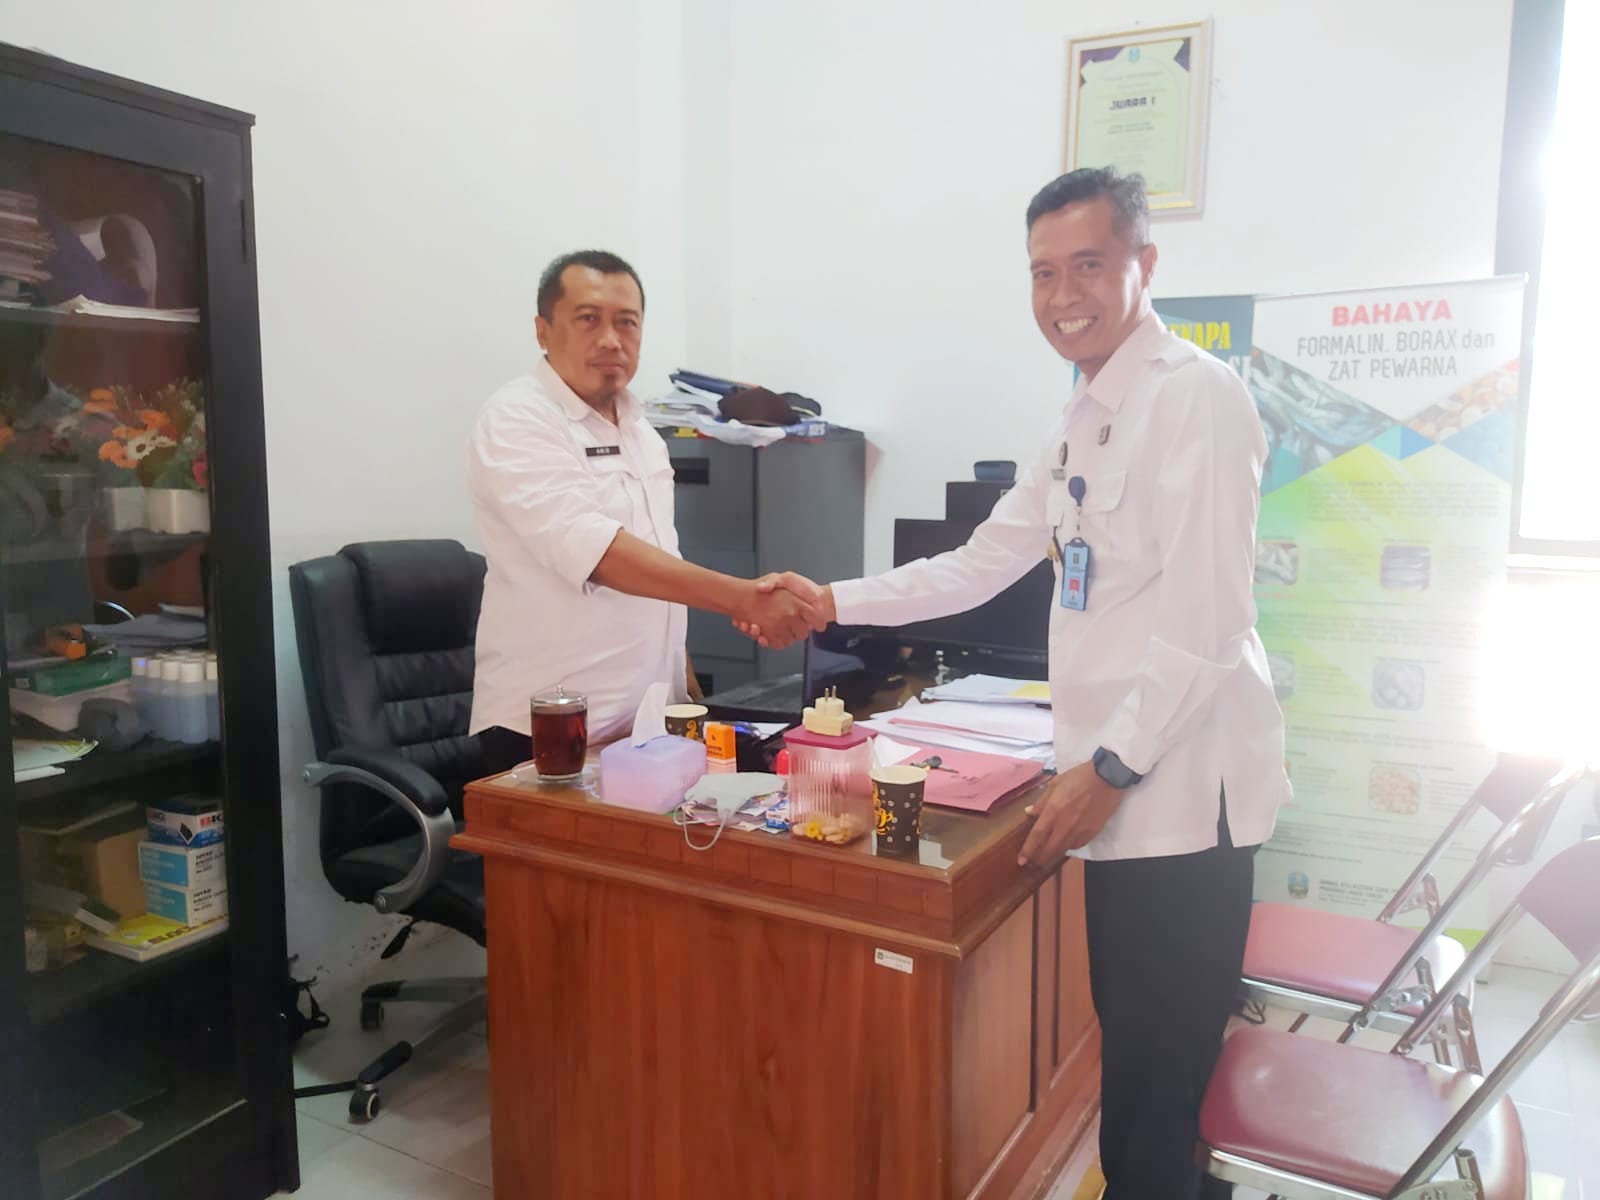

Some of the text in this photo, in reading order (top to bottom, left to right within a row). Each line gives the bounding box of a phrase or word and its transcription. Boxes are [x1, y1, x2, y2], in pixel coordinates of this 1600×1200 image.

[1331, 298, 1453, 327] BAHAYA
[1396, 328, 1457, 353] BORAX
[1462, 327, 1495, 349] dan
[1328, 355, 1457, 381] ZAT PEWARNA
